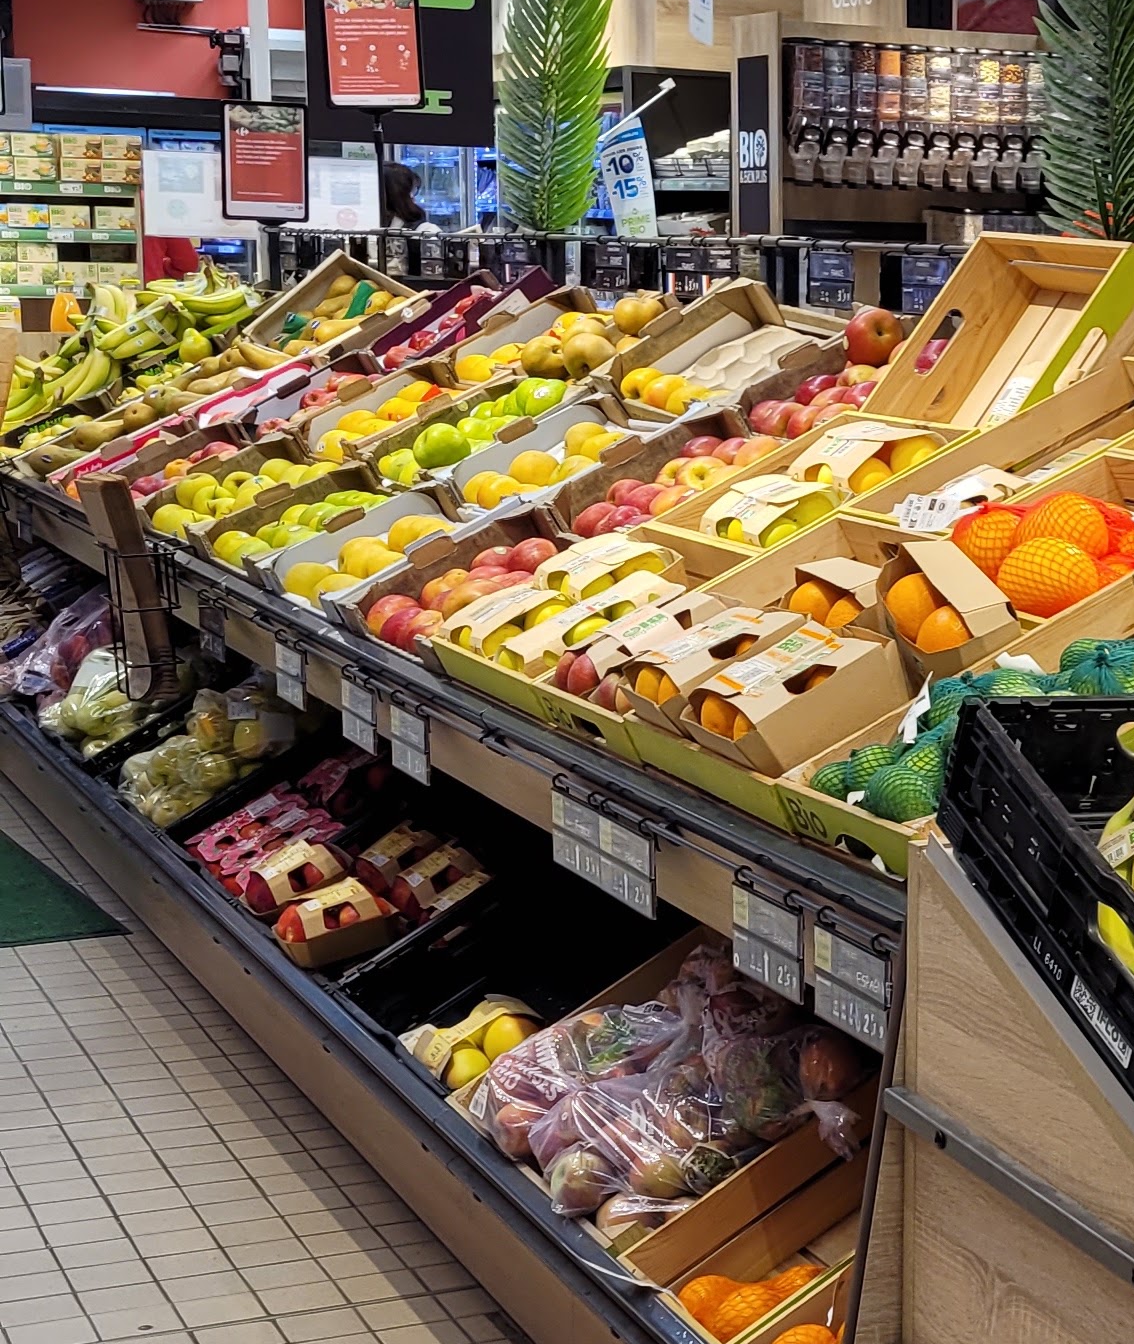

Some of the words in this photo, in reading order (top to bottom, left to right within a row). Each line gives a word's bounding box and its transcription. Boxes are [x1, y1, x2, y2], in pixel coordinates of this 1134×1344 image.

[740, 129, 767, 168] BIO
[622, 215, 651, 227] PRIME
[786, 797, 828, 838] Bio
[1033, 936, 1042, 955] LL
[1044, 953, 1062, 981] 6410
